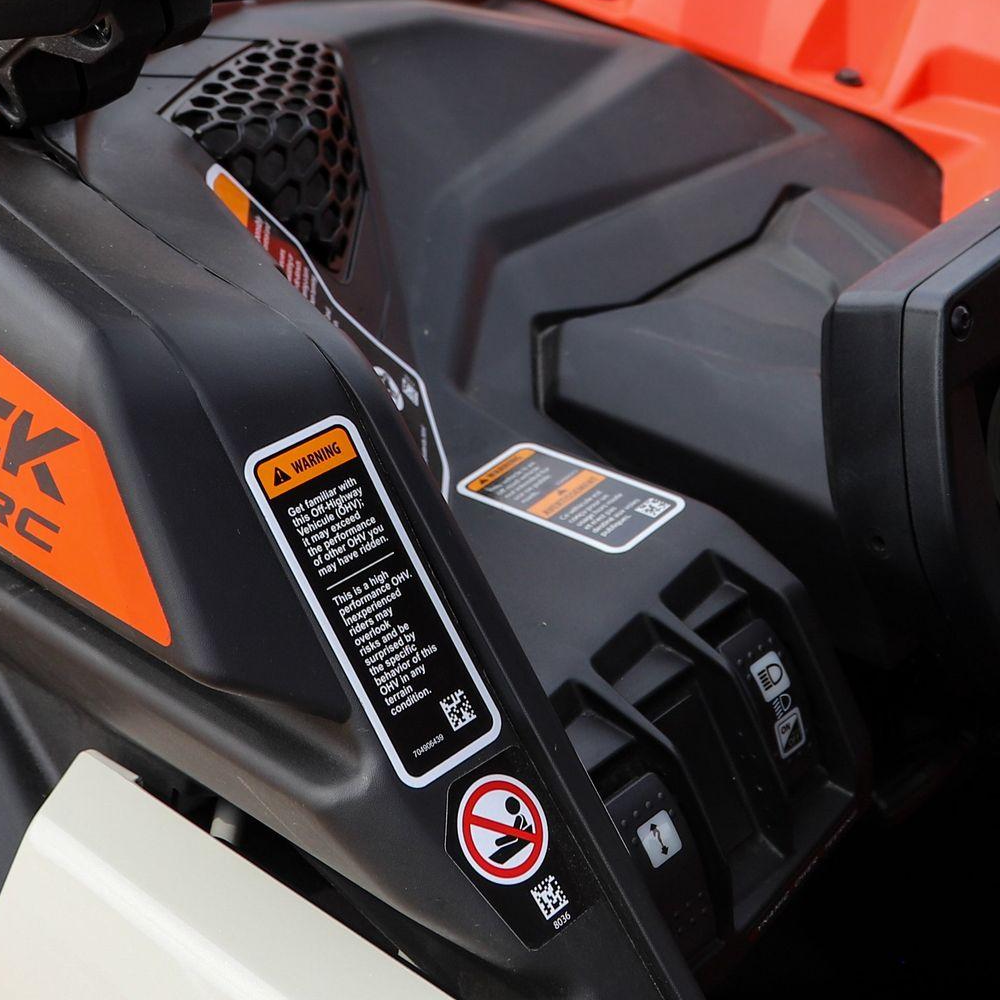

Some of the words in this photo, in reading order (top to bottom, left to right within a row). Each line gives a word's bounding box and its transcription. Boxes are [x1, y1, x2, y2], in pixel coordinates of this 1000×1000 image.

[291, 441, 342, 474] WARNING
[287, 503, 305, 517] Get
[304, 487, 337, 509] familiar
[338, 477, 357, 492] with
[292, 514, 310, 527] this
[310, 486, 363, 518] Off-Highway
[296, 513, 335, 537] Vehicule
[302, 538, 310, 548] it
[310, 528, 329, 543] may
[331, 511, 361, 532] exceed
[307, 545, 323, 557] the
[323, 516, 376, 549] performance
[313, 554, 323, 567] of
[324, 545, 346, 561] other
[347, 532, 367, 548] OHV
[367, 524, 385, 540] you
[318, 562, 337, 577] may
[337, 552, 359, 567] have
[359, 535, 389, 555] ridden.
[332, 591, 353, 606] This
[353, 586, 362, 595] is
[363, 582, 369, 590] a
[369, 570, 389, 587] high
[338, 583, 391, 617] performance
[391, 569, 413, 587] OHV.
[340, 588, 401, 627] Inexperienced
[348, 617, 374, 637] riders
[375, 606, 394, 622] may
[354, 620, 392, 647] overlook
[359, 640, 381, 657] risks
[382, 630, 398, 644] and
[398, 622, 409, 635] be
[364, 638, 404, 667] surprised
[405, 631, 416, 646] by
[369, 663, 384, 677] the
[385, 643, 417, 668] specific
[374, 662, 411, 687] behavior
[411, 651, 422, 664] of
[422, 643, 438, 659] this
[379, 678, 400, 696] OHV
[400, 673, 410, 684] in
[411, 664, 426, 679] any
[384, 684, 413, 706] terrain
[390, 688, 432, 716] condition.
[412, 733, 445, 758] 704906439
[553, 911, 571, 930] 8036
